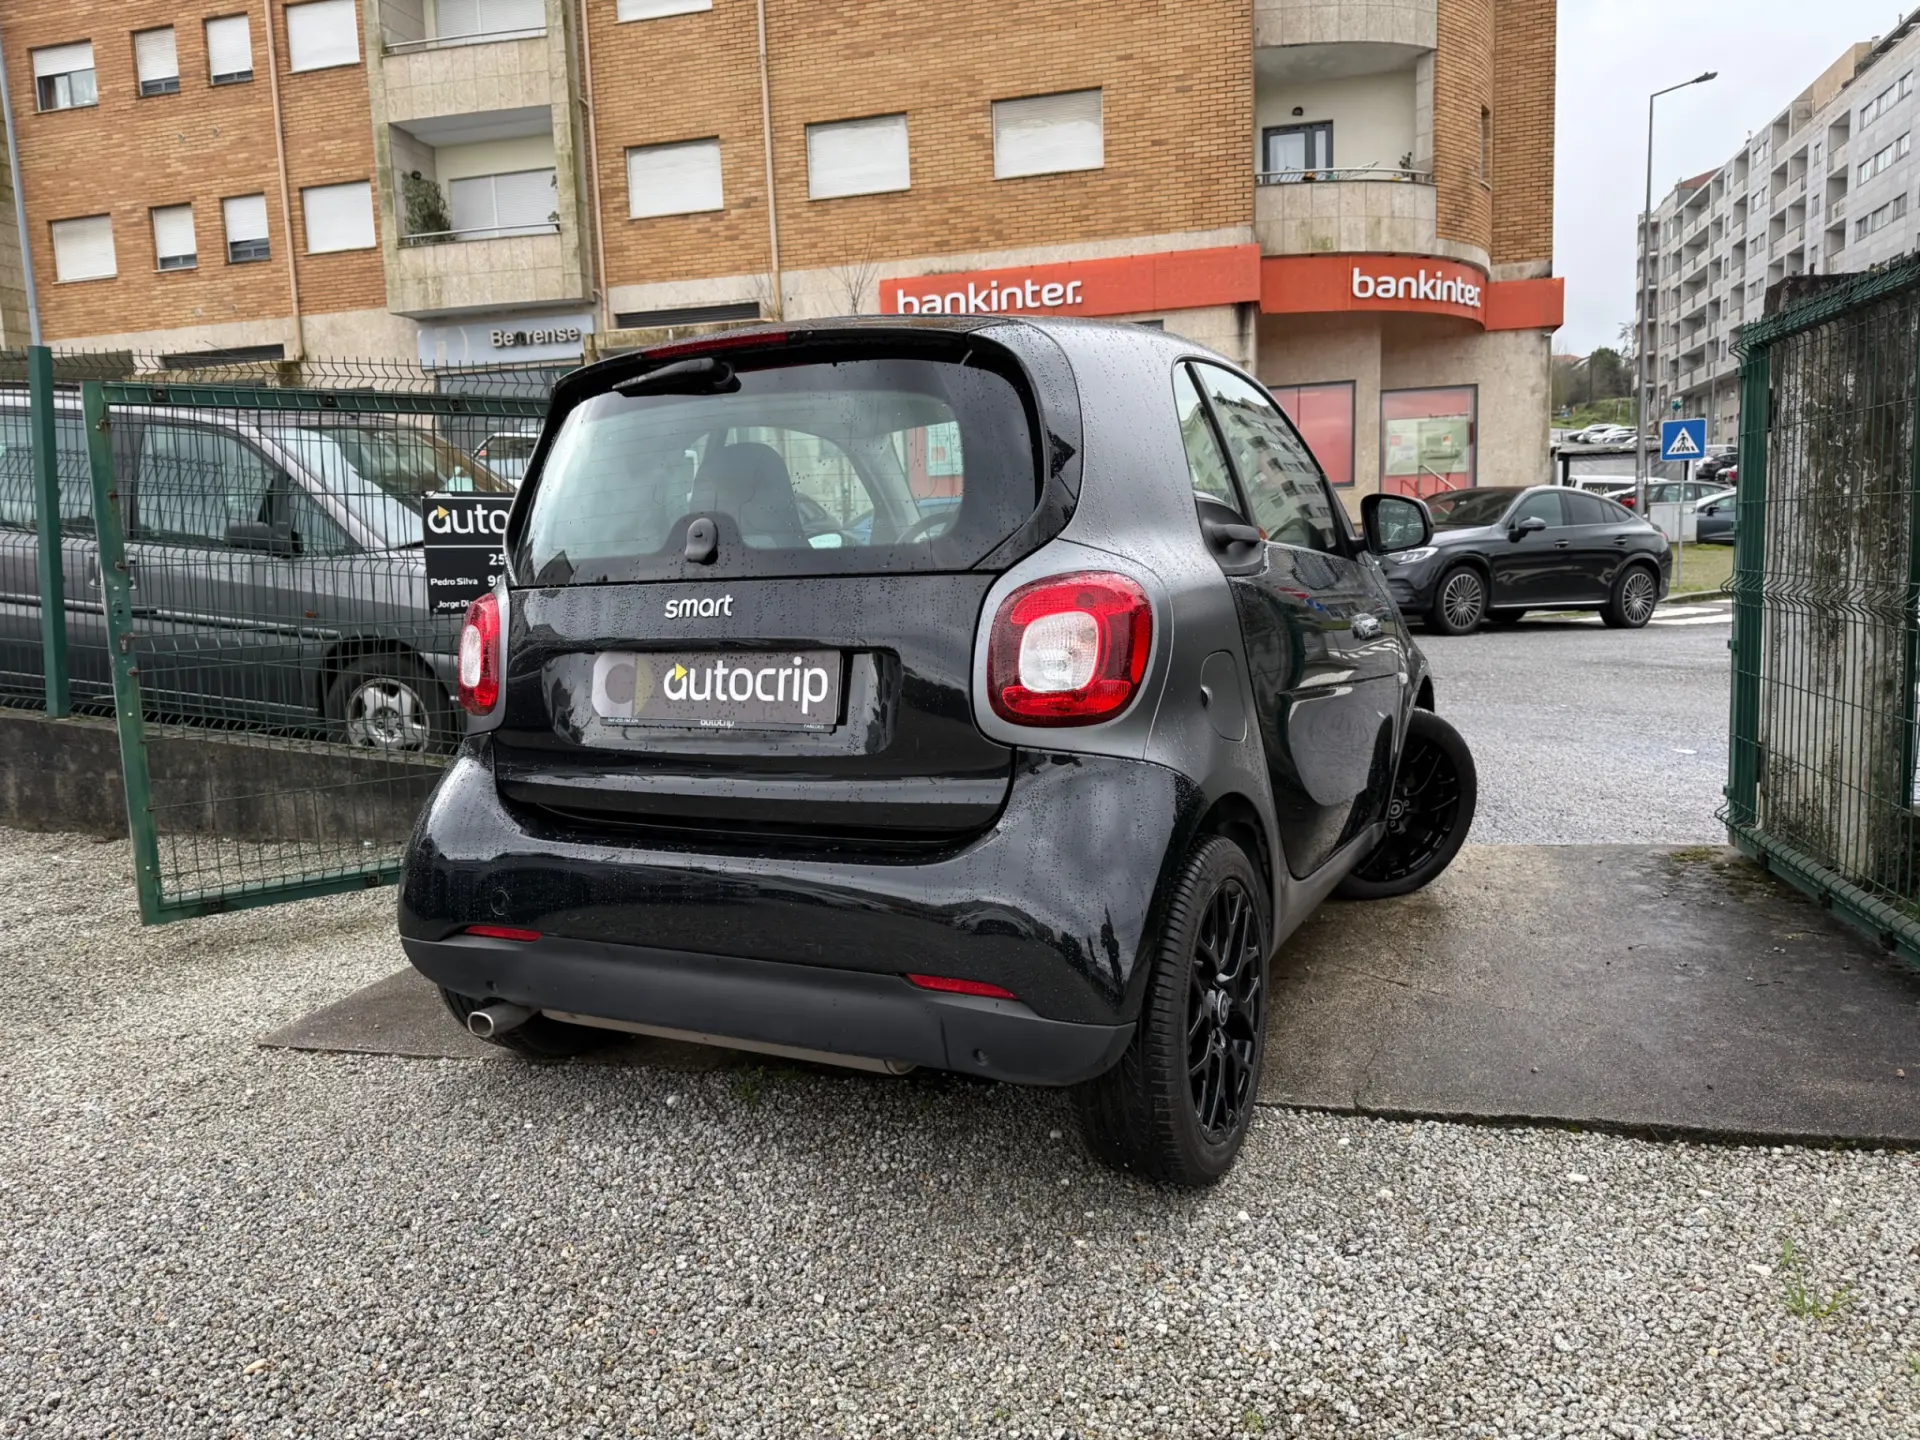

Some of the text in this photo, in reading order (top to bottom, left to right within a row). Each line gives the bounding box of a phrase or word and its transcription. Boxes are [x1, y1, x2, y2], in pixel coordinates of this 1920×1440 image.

[896, 279, 1083, 314] bankinter.
[1352, 267, 1481, 308] bankinter.
[430, 577, 456, 586] Pedro
[456, 577, 479, 586] Silva
[437, 599, 473, 610] Jorge Di
[664, 594, 733, 619] smart
[663, 656, 829, 714] autocrip
